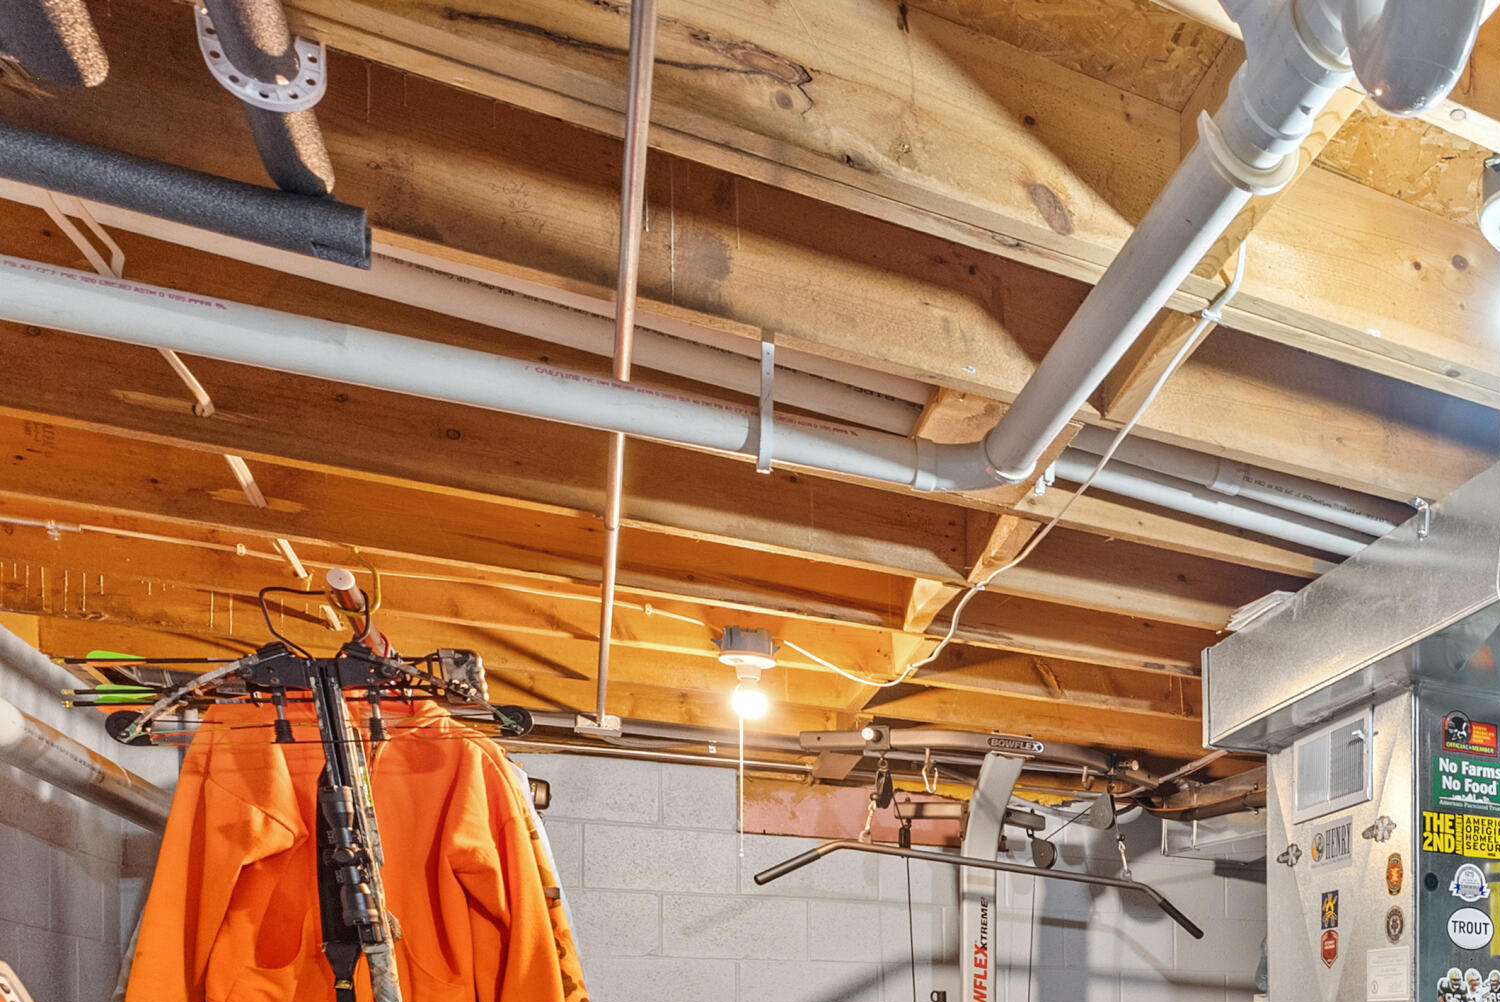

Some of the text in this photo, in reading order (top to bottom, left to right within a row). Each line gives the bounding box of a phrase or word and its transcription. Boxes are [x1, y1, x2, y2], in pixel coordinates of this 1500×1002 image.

[991, 738, 1039, 751] BOWFLEX
[1439, 757, 1458, 773] No
[1442, 775, 1497, 796] No Food
[1422, 811, 1455, 834] THE
[1325, 823, 1352, 859] HENRY
[1422, 832, 1455, 854] 2ND
[1452, 920, 1490, 935] TROUT
